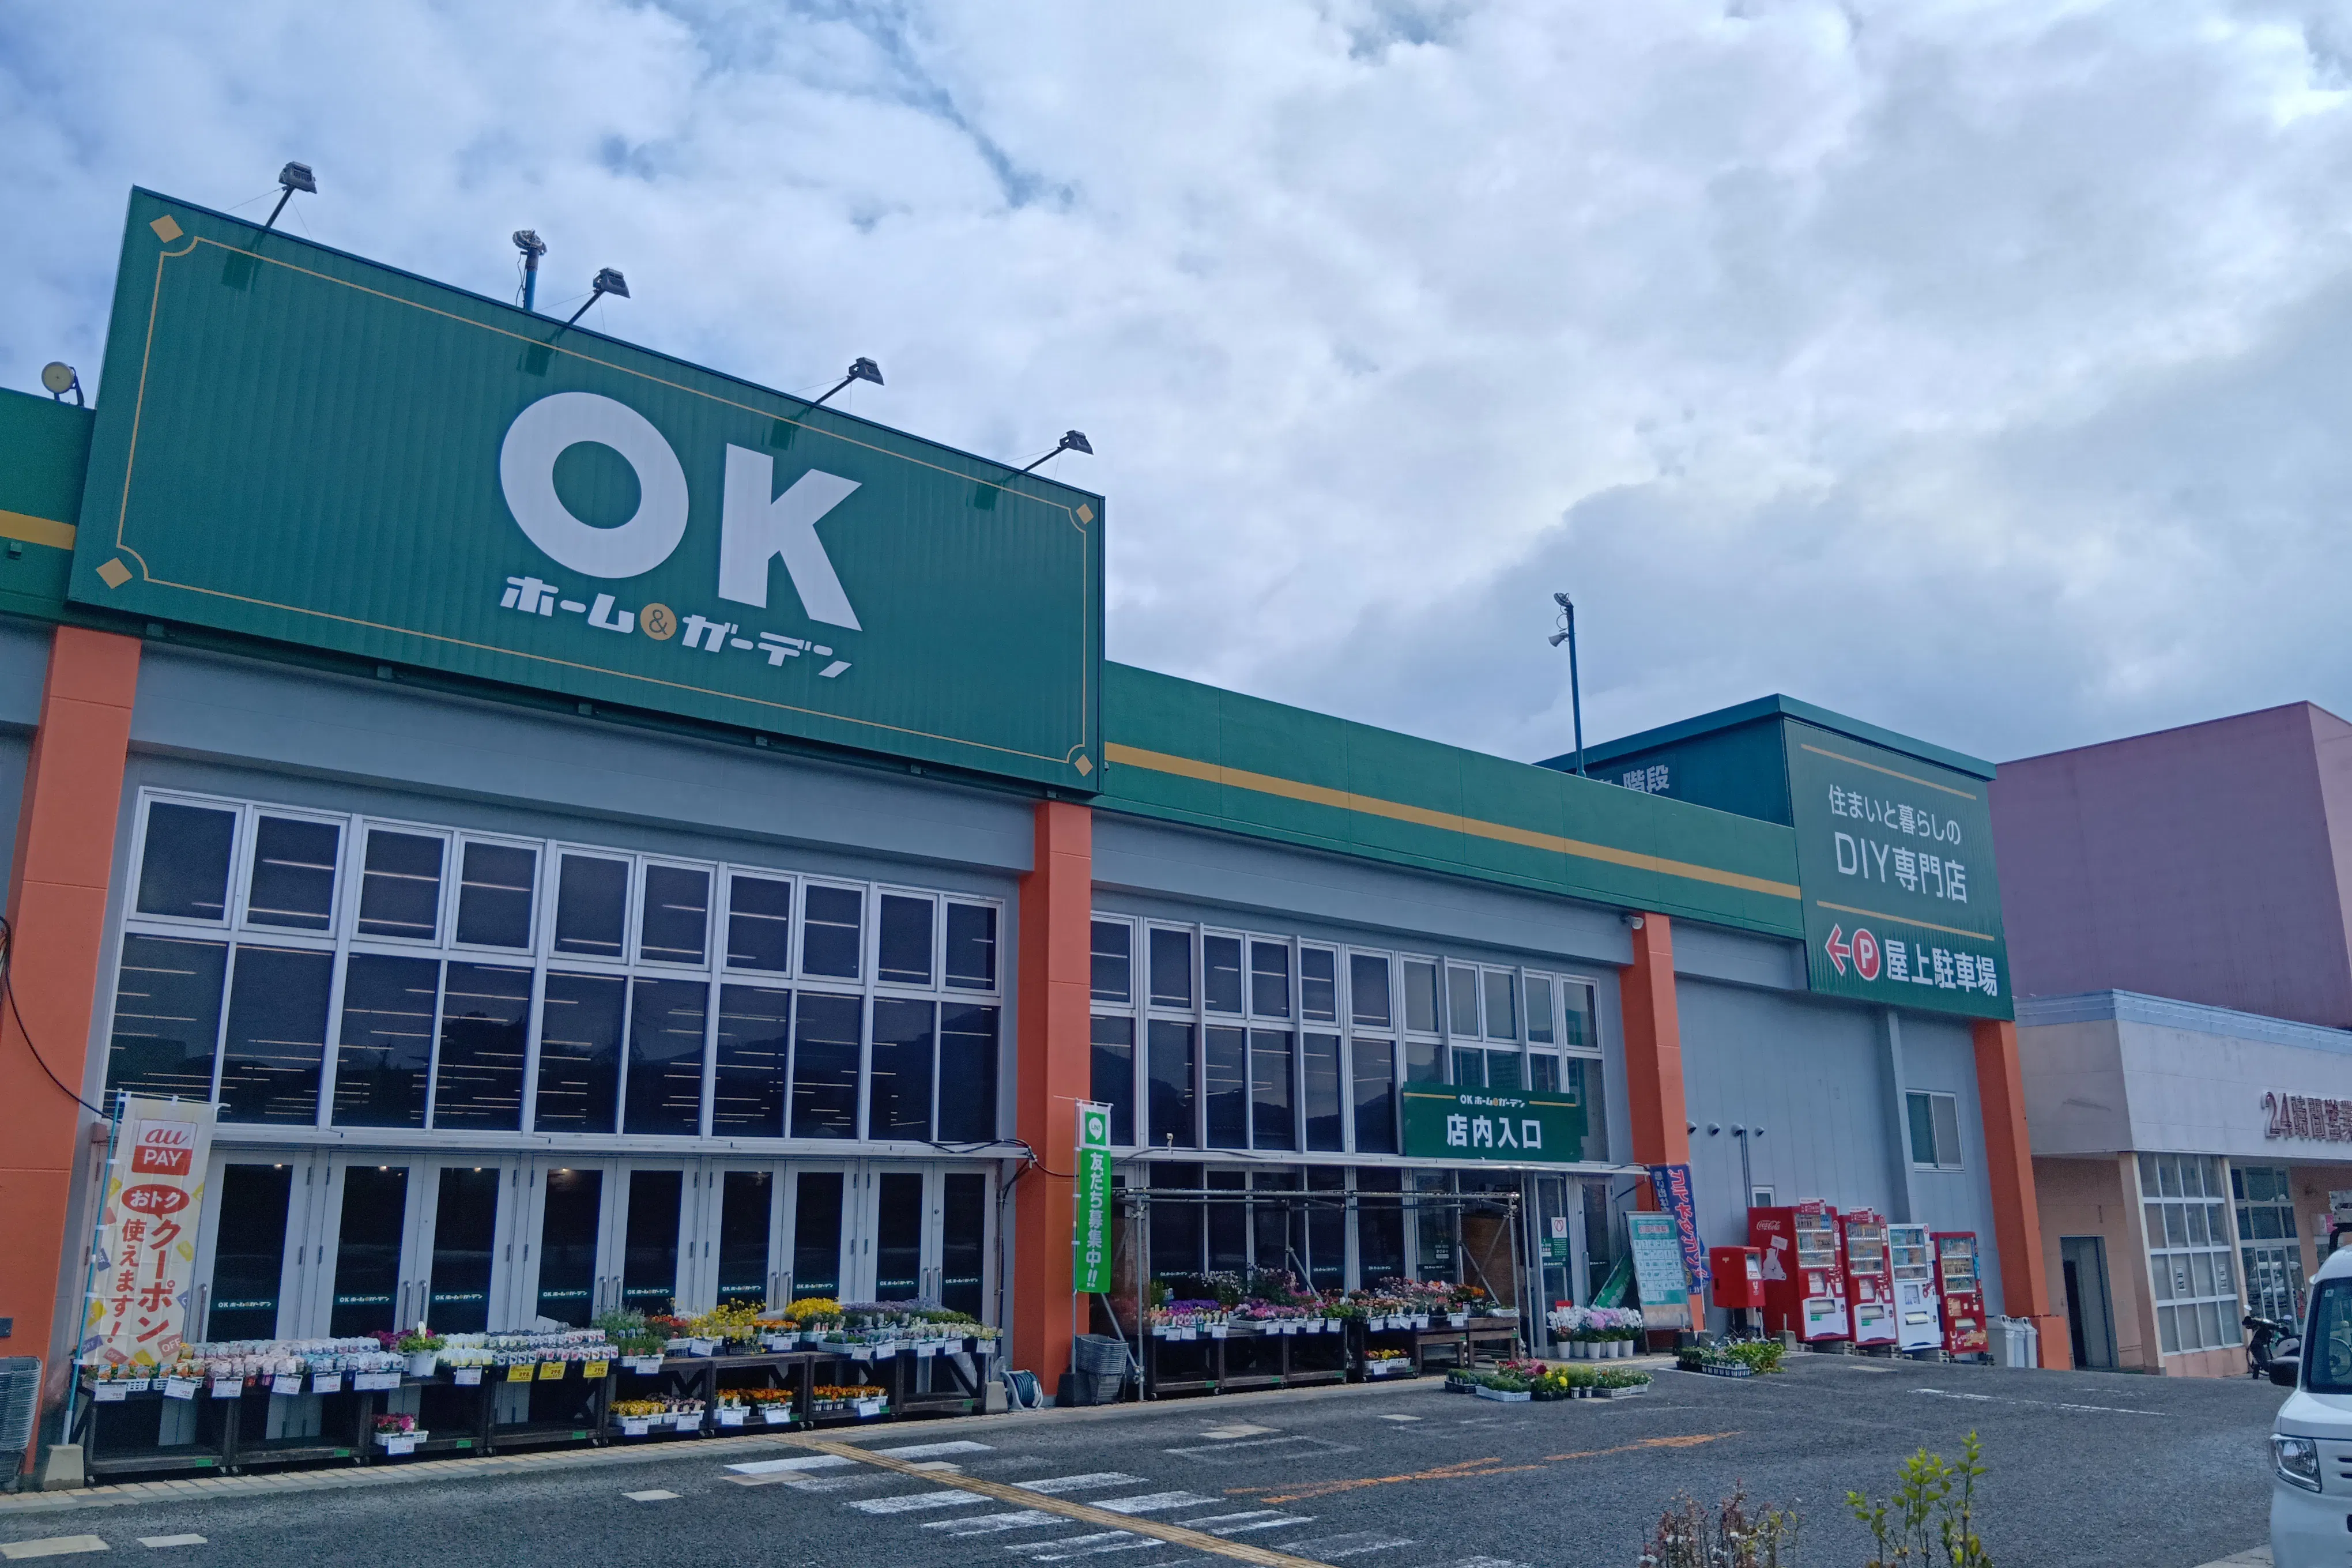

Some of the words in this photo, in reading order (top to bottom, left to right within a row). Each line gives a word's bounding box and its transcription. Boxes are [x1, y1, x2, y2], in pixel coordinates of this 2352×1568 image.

[500, 391, 863, 632] OK
[500, 576, 853, 678] ホーム&ガーデン
[1599, 764, 1669, 793] 階段
[1828, 784, 1961, 845] 住まいと暮らしの
[1834, 831, 1967, 903] DIY専門店
[1859, 938, 1874, 969] P
[1884, 938, 1999, 997] 屋上駐車場
[1460, 1094, 1473, 1105] OK
[145, 1126, 189, 1145] au
[1446, 1113, 1542, 1149] 店内入口
[143, 1148, 183, 1167] PAY
[130, 1190, 181, 1208] おトク
[136, 1219, 182, 1343] クーポン
